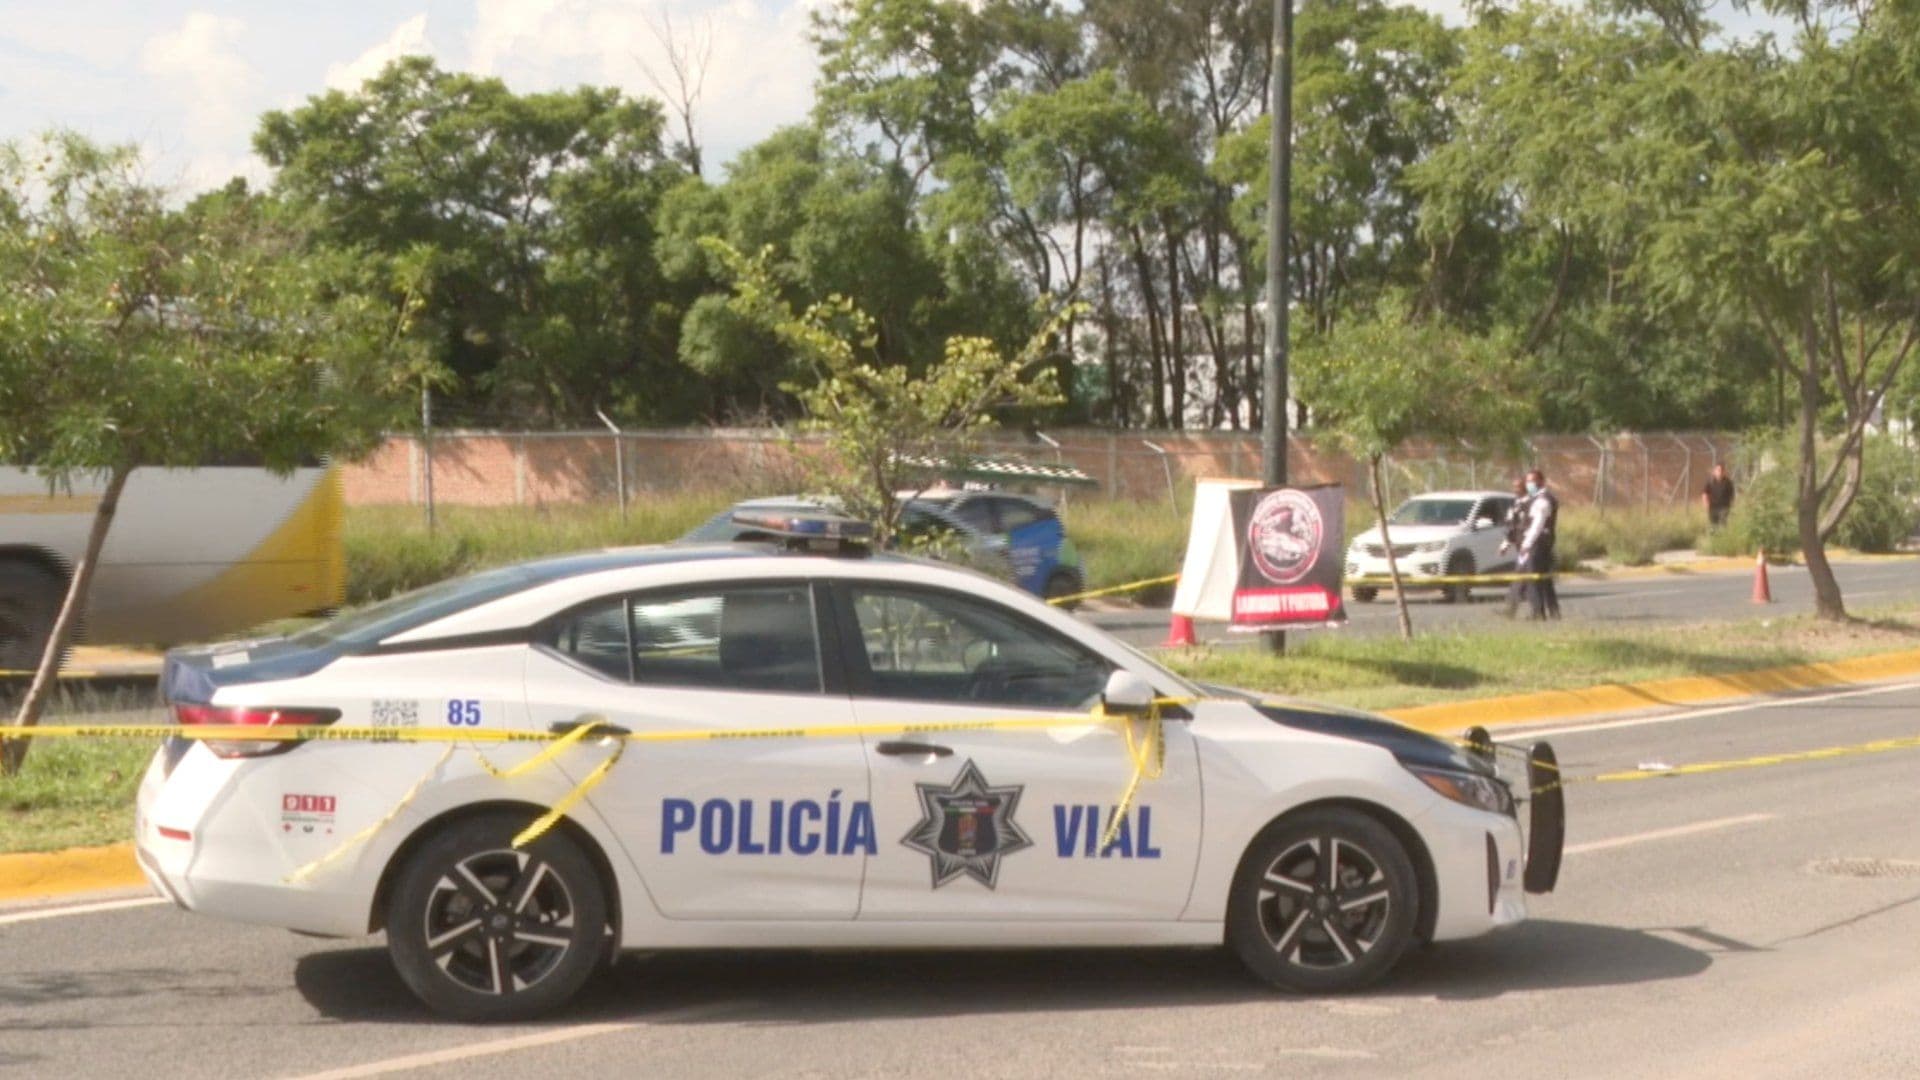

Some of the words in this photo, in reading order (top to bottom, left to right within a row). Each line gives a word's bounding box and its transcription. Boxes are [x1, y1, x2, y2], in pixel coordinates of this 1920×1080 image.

[447, 699, 481, 726] 85
[285, 796, 333, 811] 911
[660, 789, 878, 855] POLICÍA
[1053, 804, 1162, 858] VIAL
